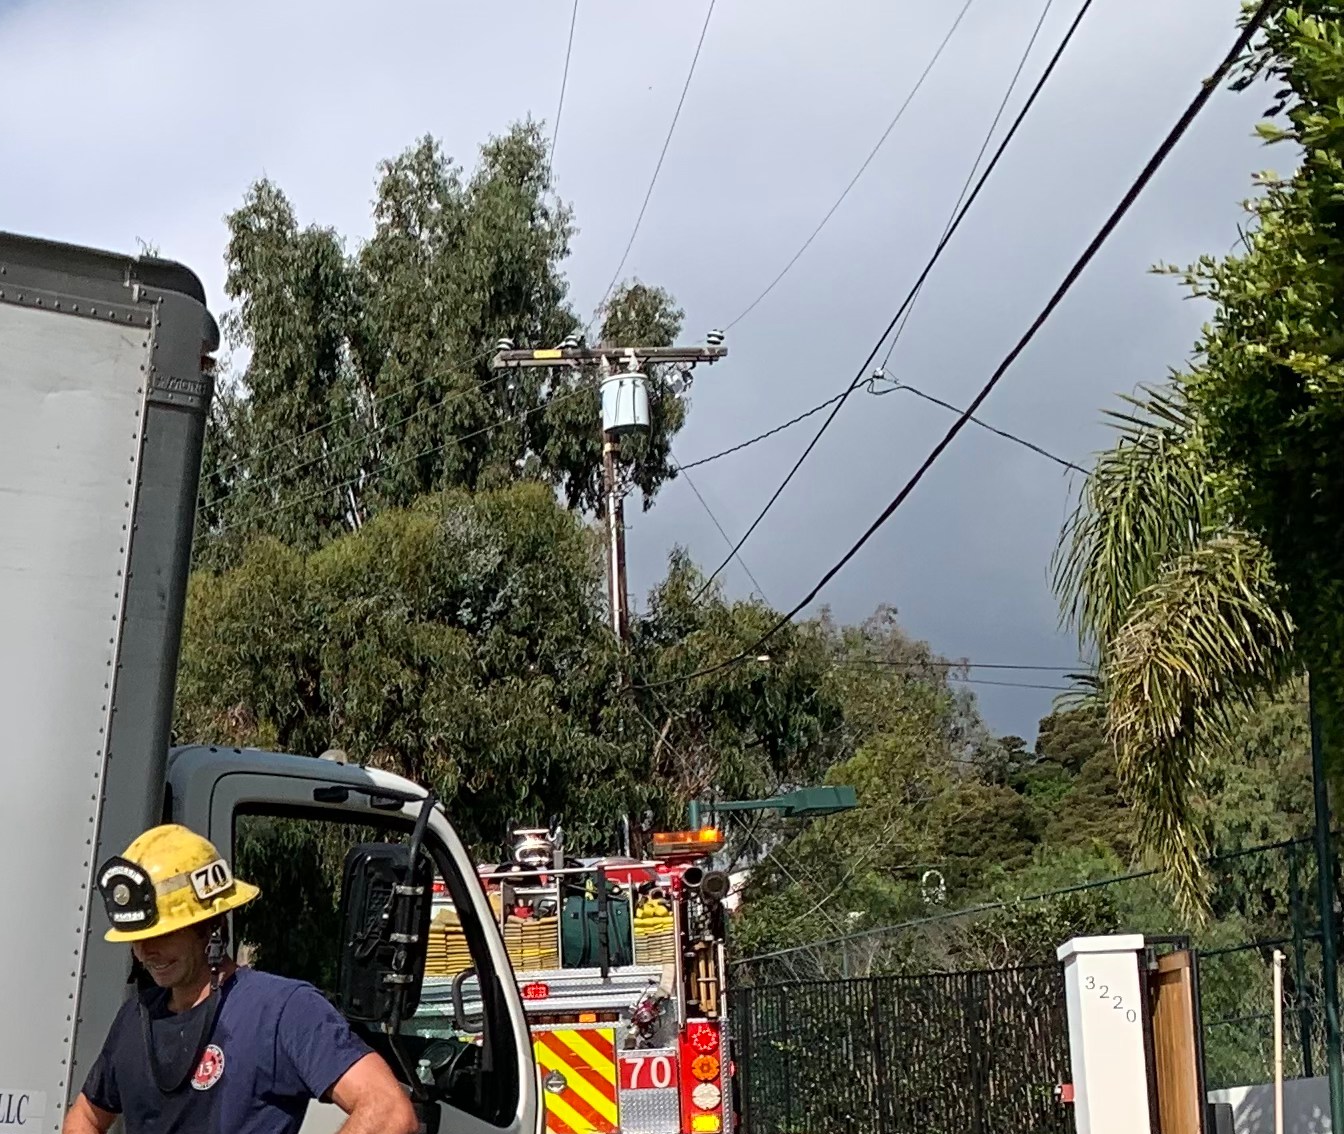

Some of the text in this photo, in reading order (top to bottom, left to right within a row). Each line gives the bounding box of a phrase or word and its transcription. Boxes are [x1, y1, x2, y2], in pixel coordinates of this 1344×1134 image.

[195, 863, 228, 894] 70
[1085, 975, 1137, 1023] 3220
[624, 1056, 672, 1089] 70
